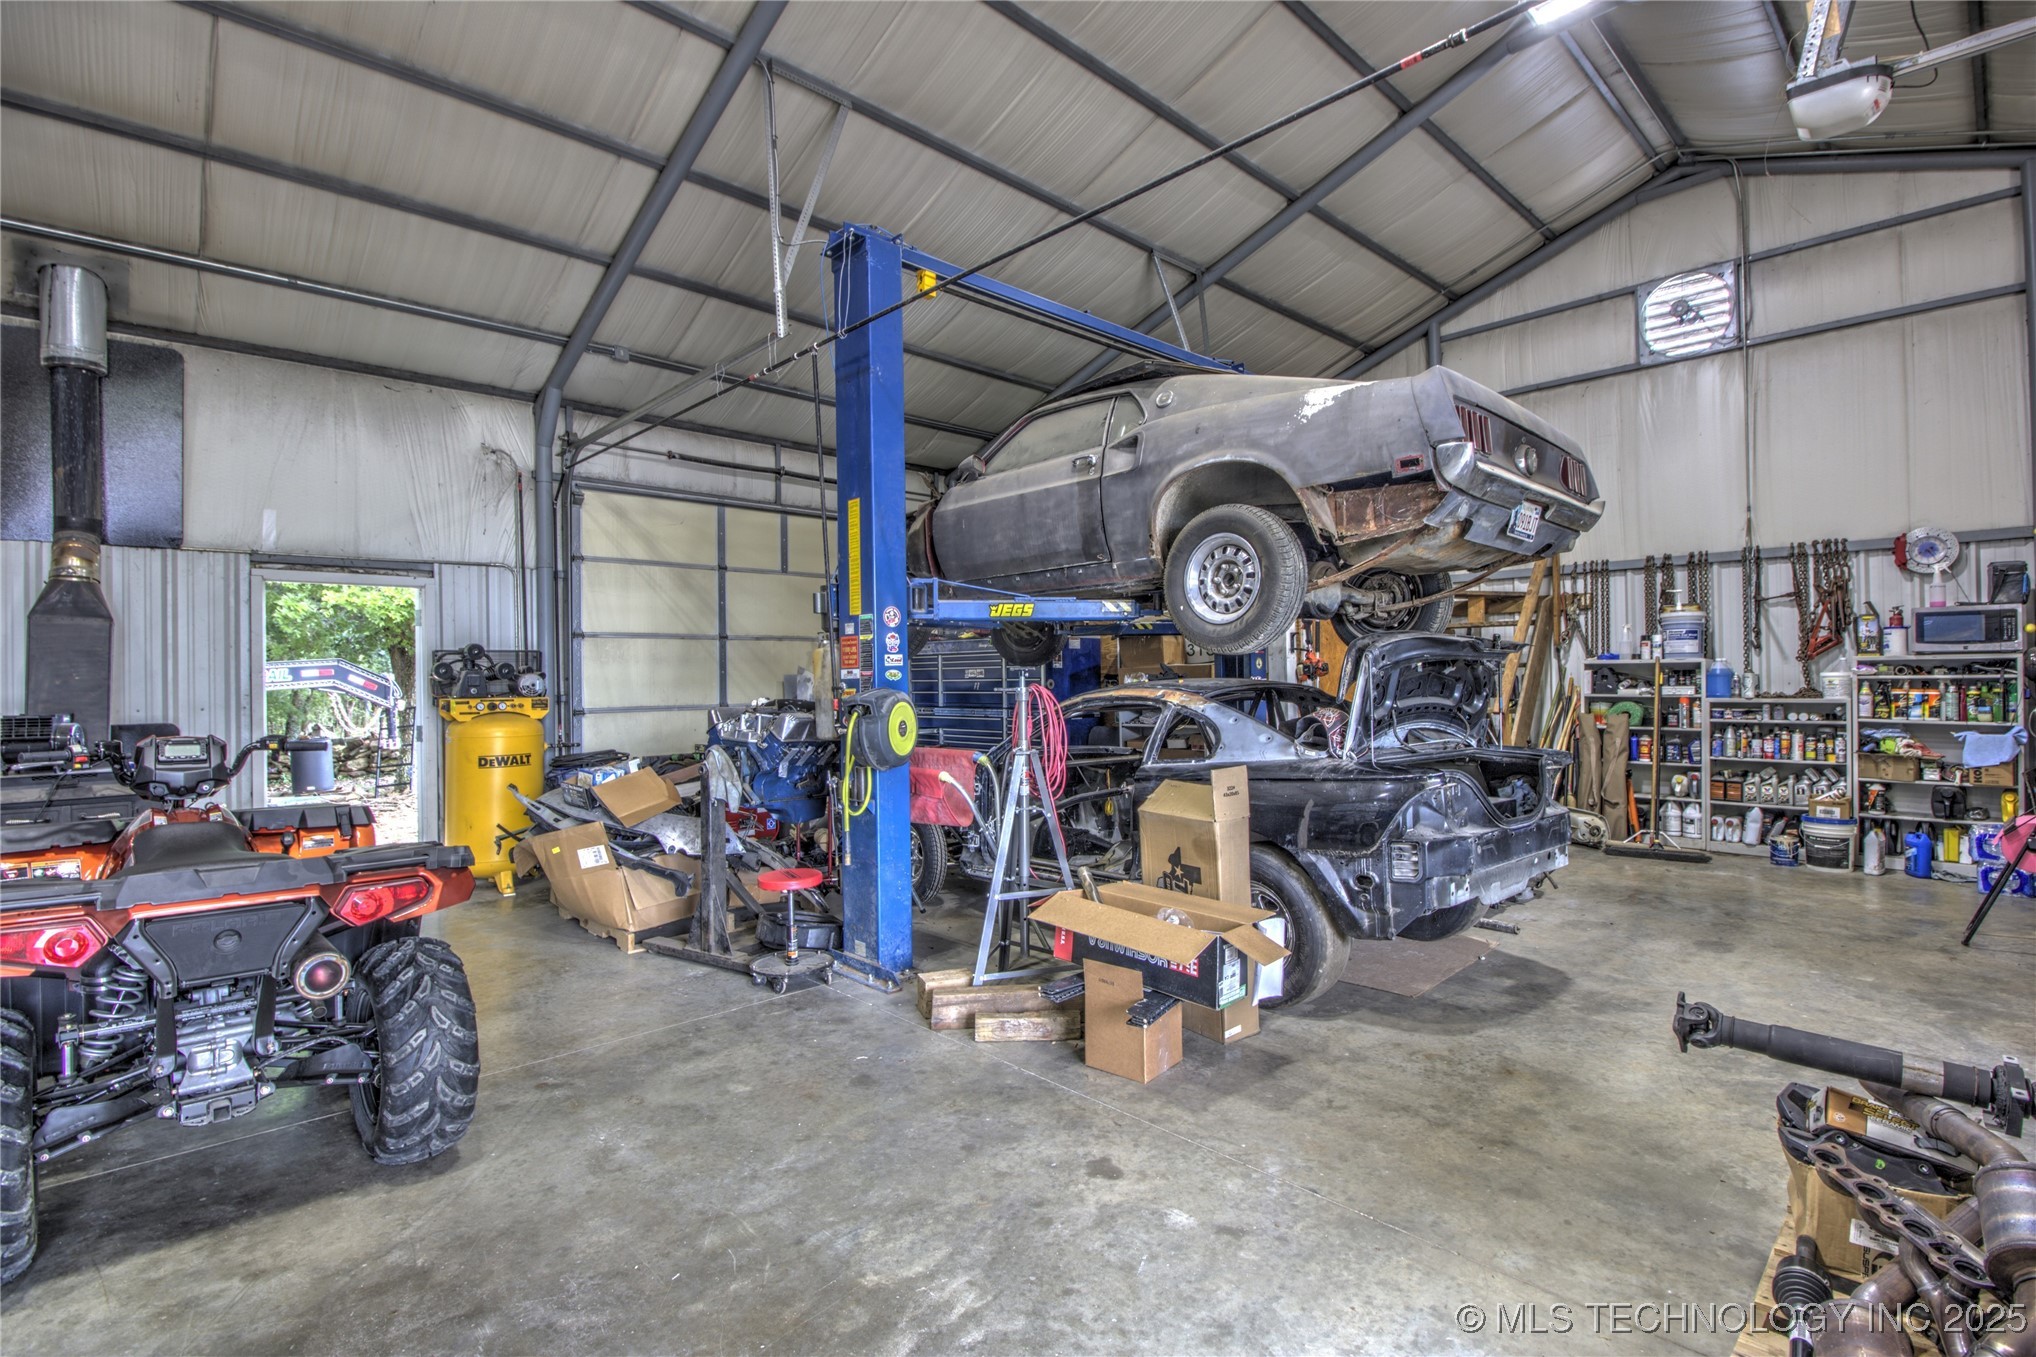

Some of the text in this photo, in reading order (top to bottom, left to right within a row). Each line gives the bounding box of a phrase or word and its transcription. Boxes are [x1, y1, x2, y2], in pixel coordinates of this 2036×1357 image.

[989, 603, 1034, 617] JEGS
[265, 668, 293, 683] AIL
[1863, 1107, 1920, 1130] SELECT
[1869, 1115, 1912, 1132] CERAMIC
